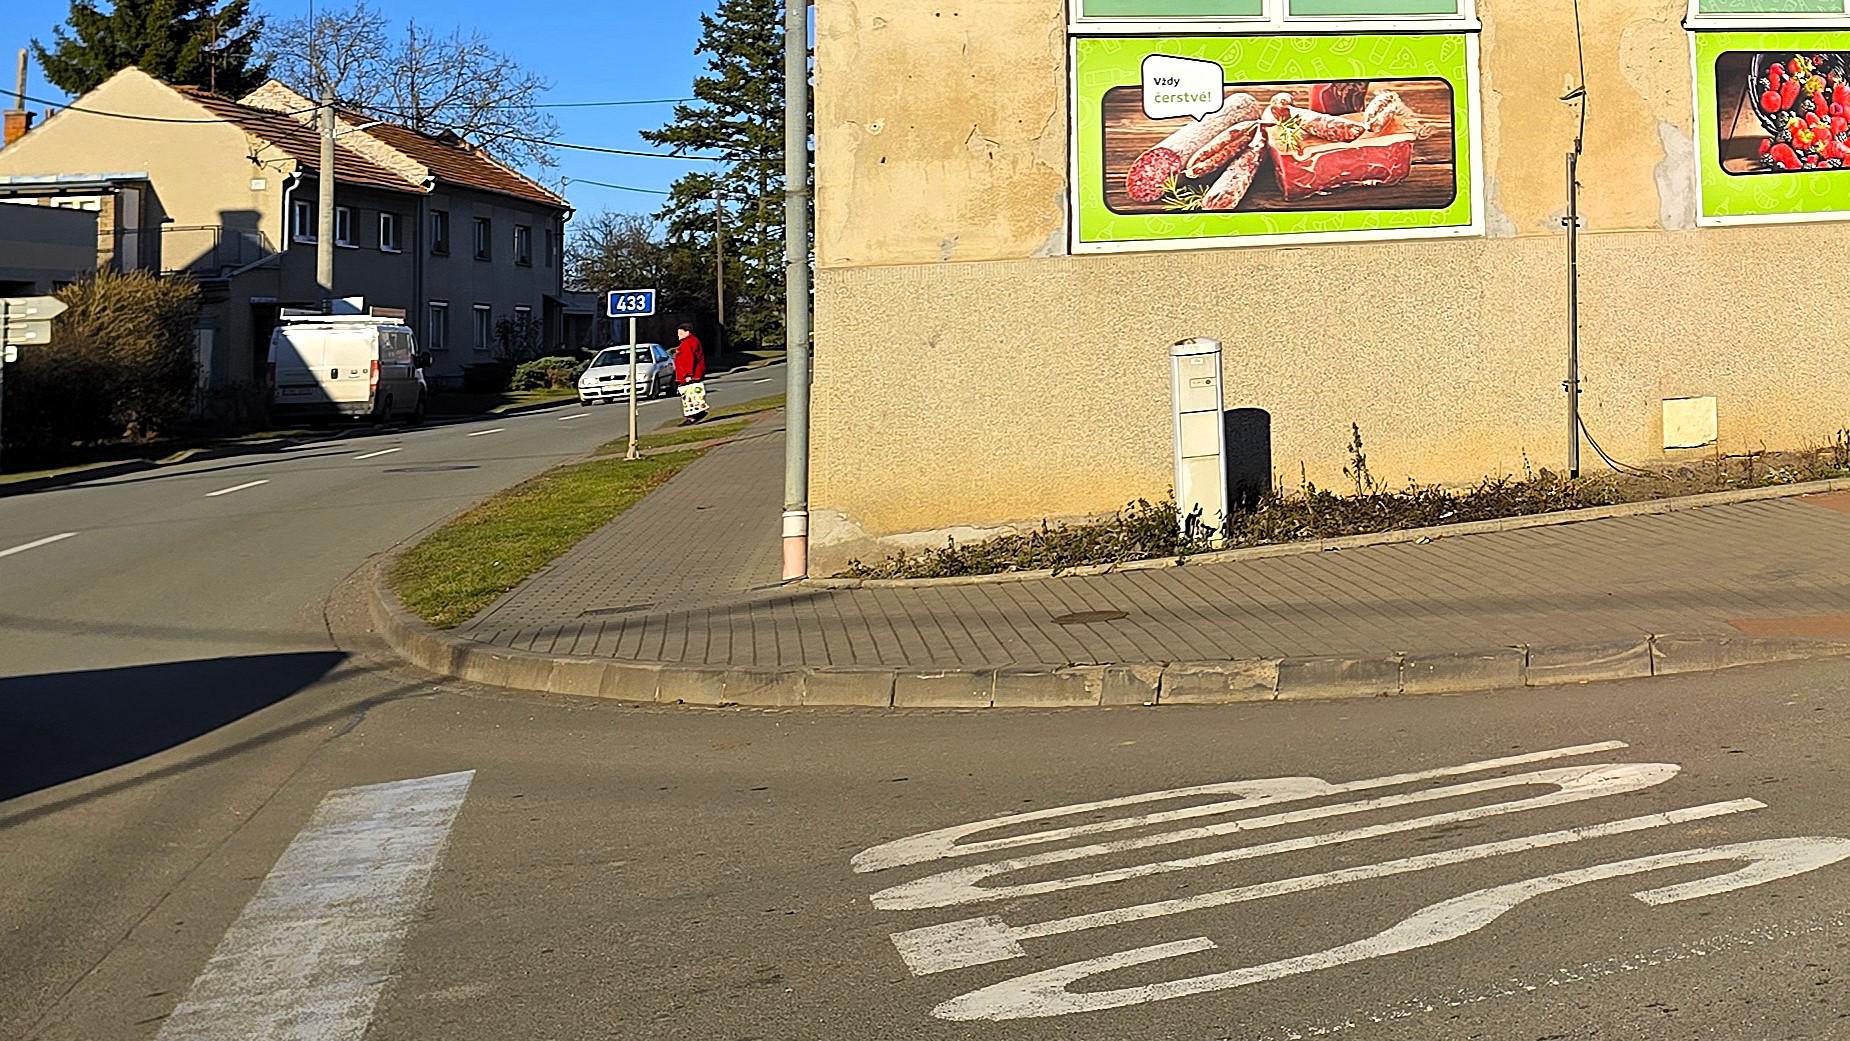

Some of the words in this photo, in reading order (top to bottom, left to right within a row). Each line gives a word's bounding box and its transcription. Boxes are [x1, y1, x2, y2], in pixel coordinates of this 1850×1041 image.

[1153, 77, 1181, 87] Vždy
[1154, 91, 1212, 103] čerstvé!
[616, 294, 646, 312] 433
